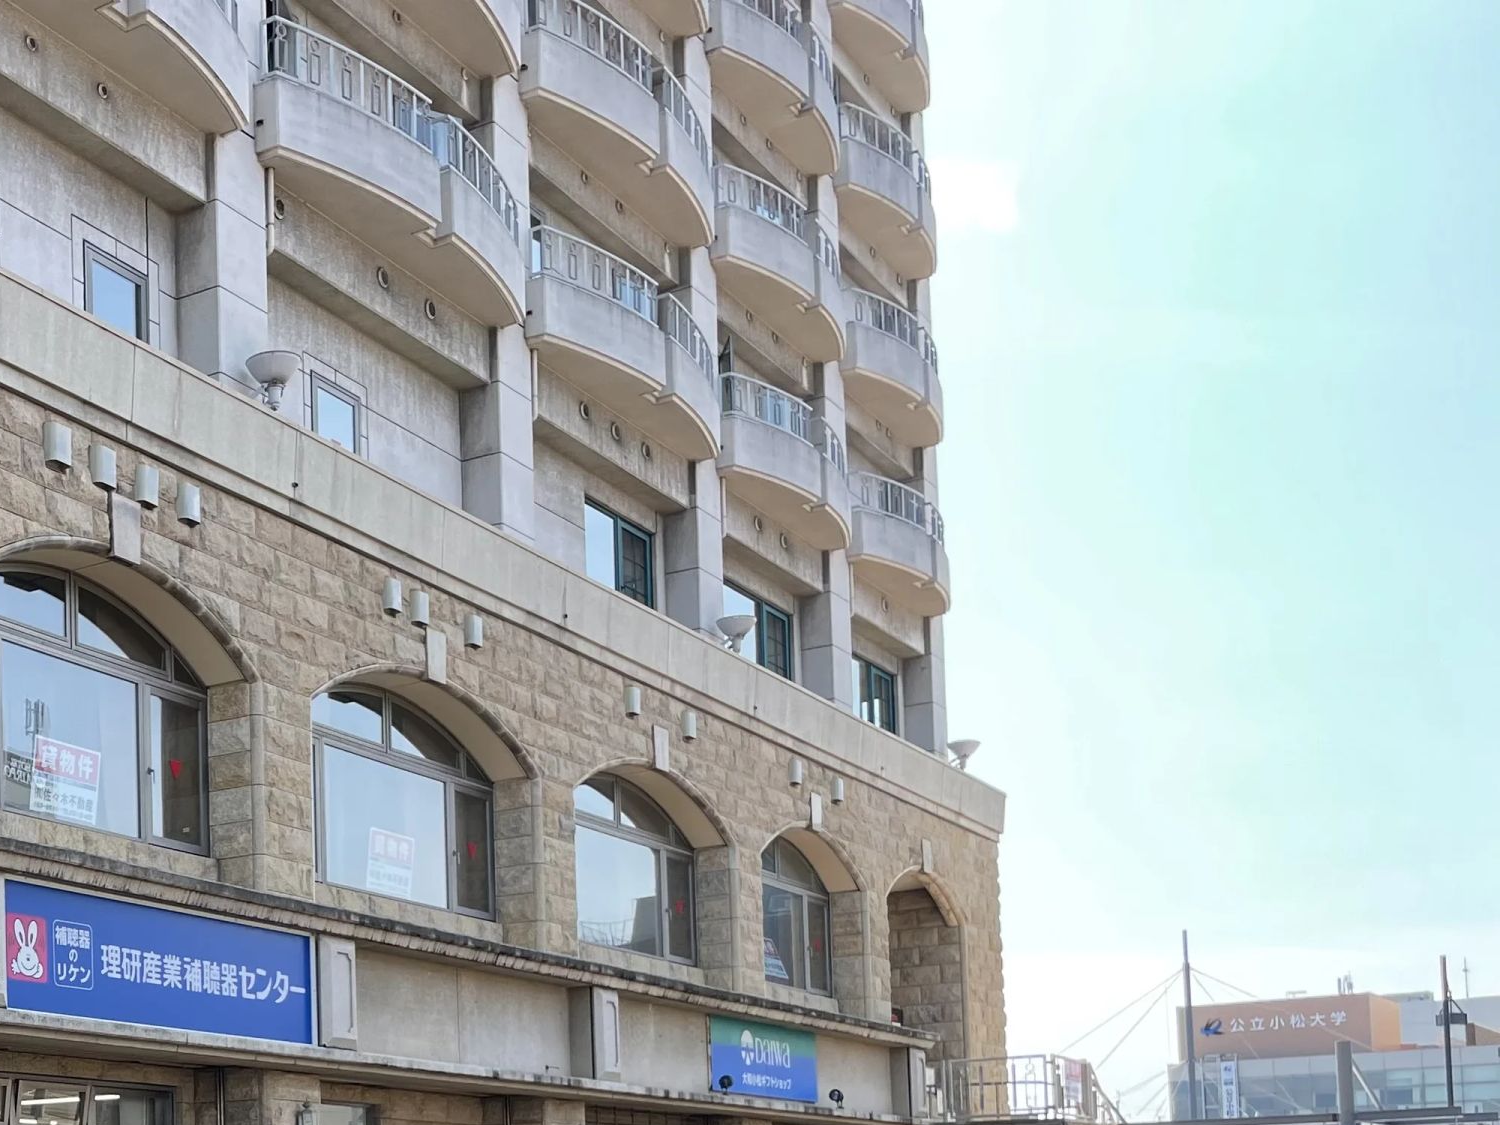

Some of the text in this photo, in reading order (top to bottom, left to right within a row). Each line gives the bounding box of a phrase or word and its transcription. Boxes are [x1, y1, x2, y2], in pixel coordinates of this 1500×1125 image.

[55, 925, 90, 949] 補聴器
[68, 949, 78, 962] の
[57, 963, 91, 983] リケン
[100, 945, 306, 1004] 理研産業補聴器センター
[1230, 1011, 1347, 1033] 公立小松大学
